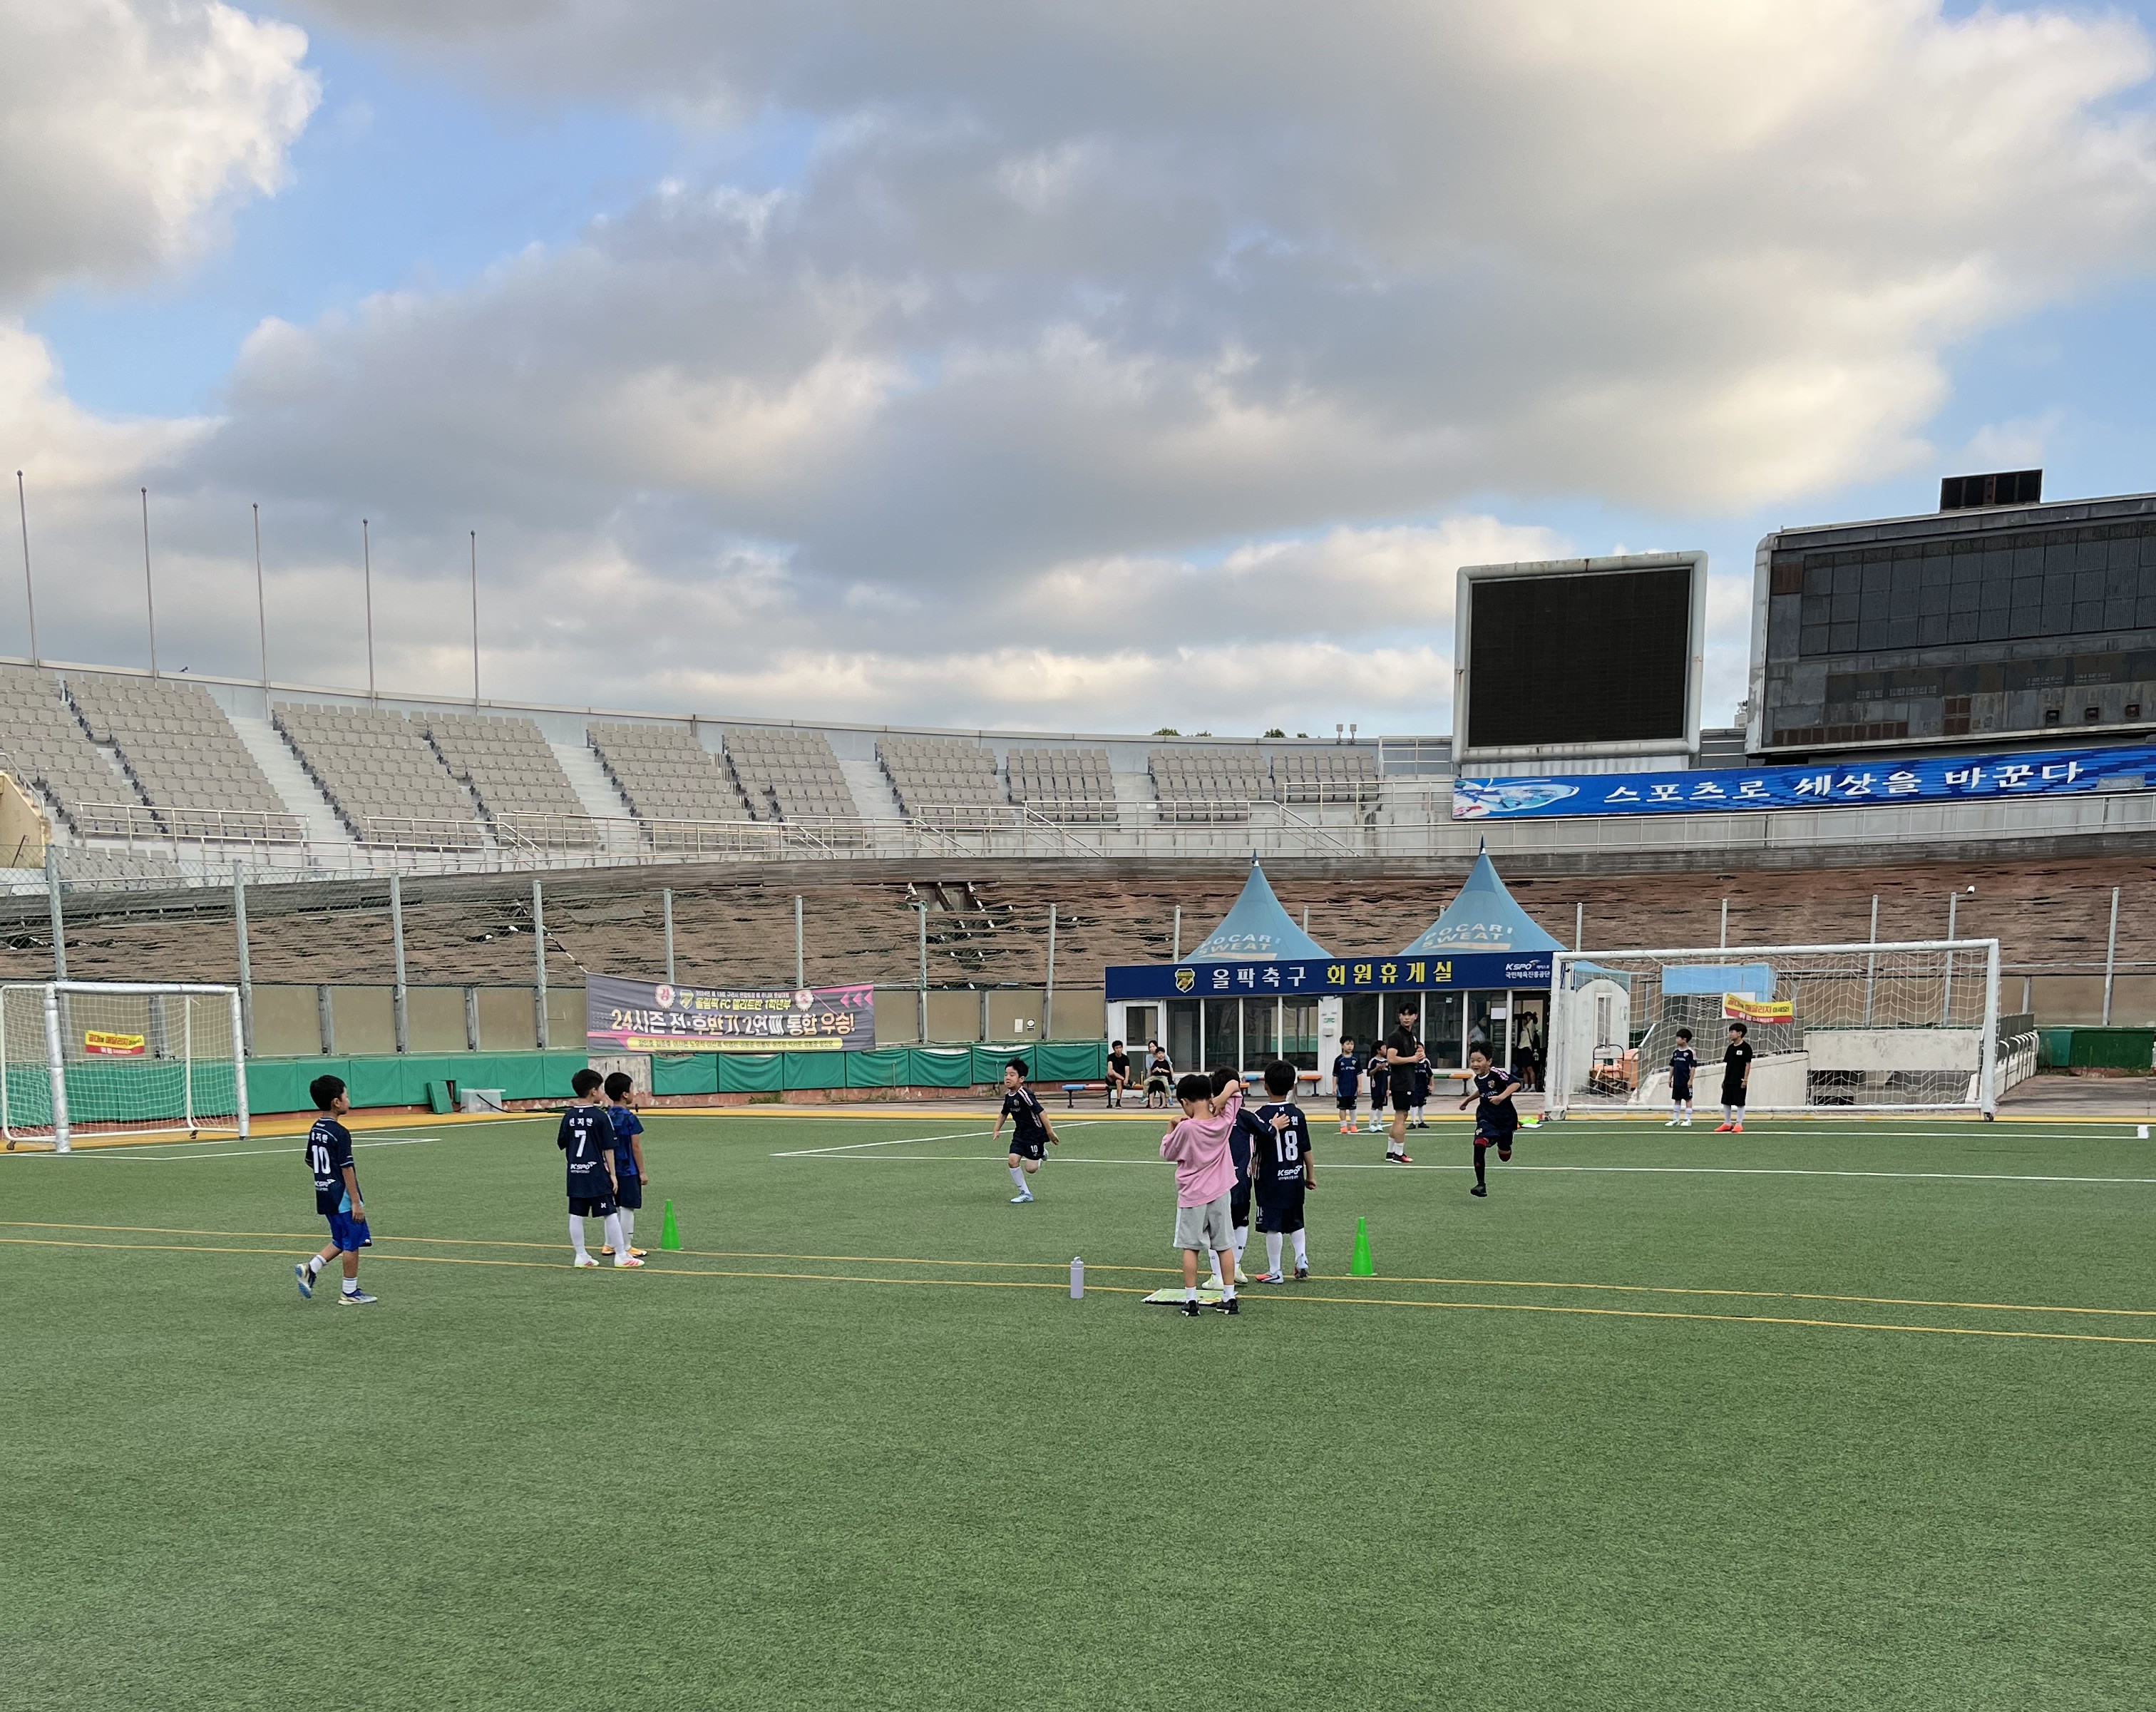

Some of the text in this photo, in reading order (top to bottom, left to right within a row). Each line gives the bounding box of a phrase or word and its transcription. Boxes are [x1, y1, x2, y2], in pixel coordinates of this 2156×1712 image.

[1603, 761, 2083, 803] 스포츠로 세상을 바꾼다
[1201, 933, 1280, 950] POCARI
[1422, 933, 1503, 948] SWEAT
[1424, 923, 1513, 940] POCARI
[1198, 943, 1272, 954] SWEAT
[1211, 960, 1452, 989] 올팍축구 회원휴게실
[720, 999, 732, 1010] FC
[611, 1009, 666, 1035] 24시즌
[786, 1013, 817, 1036] 통합
[575, 1129, 587, 1157] 7
[1030, 1144, 1038, 1153] 10
[1276, 1130, 1298, 1162] 18
[312, 1144, 331, 1174] 10
